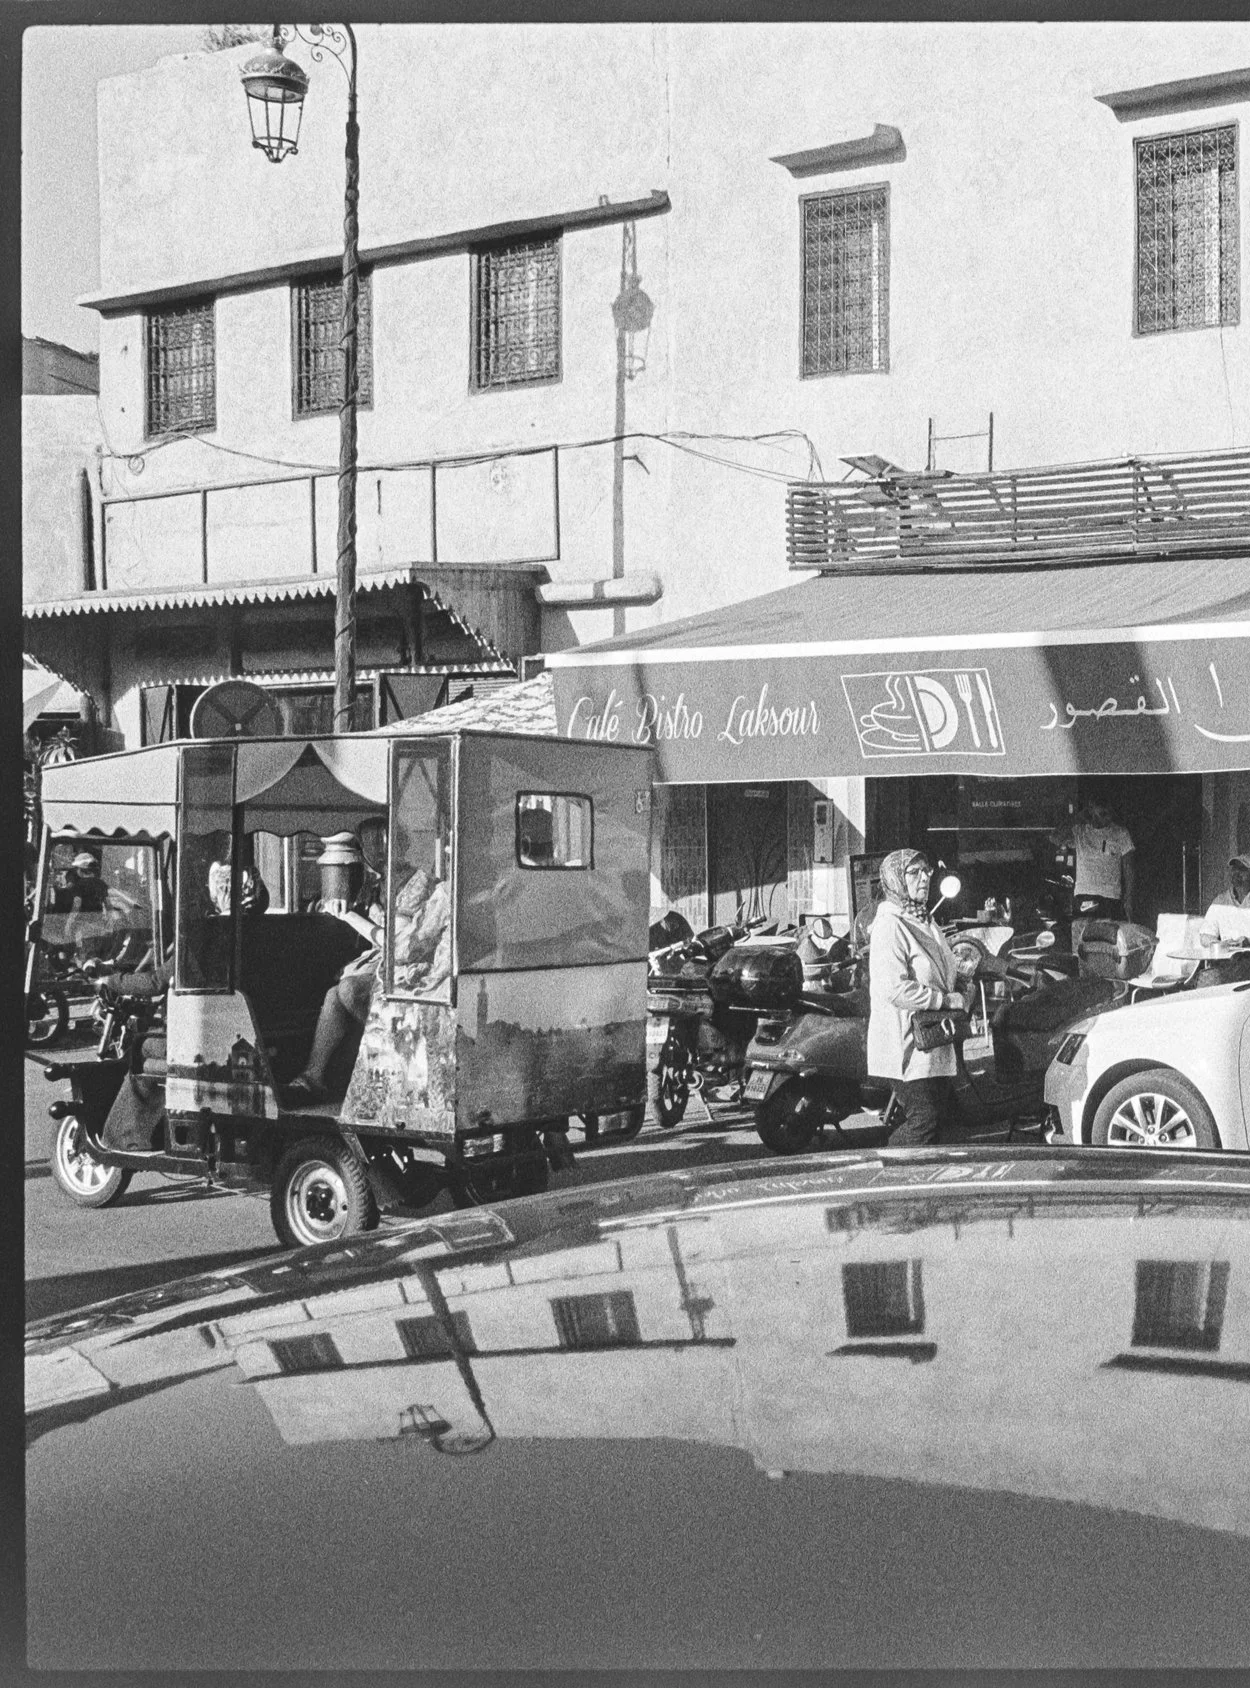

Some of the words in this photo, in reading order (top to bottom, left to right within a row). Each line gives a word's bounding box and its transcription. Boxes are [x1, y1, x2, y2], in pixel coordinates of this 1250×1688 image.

[567, 688, 621, 741] Café
[632, 692, 704, 744] Bistro
[717, 683, 821, 745] Laksour
